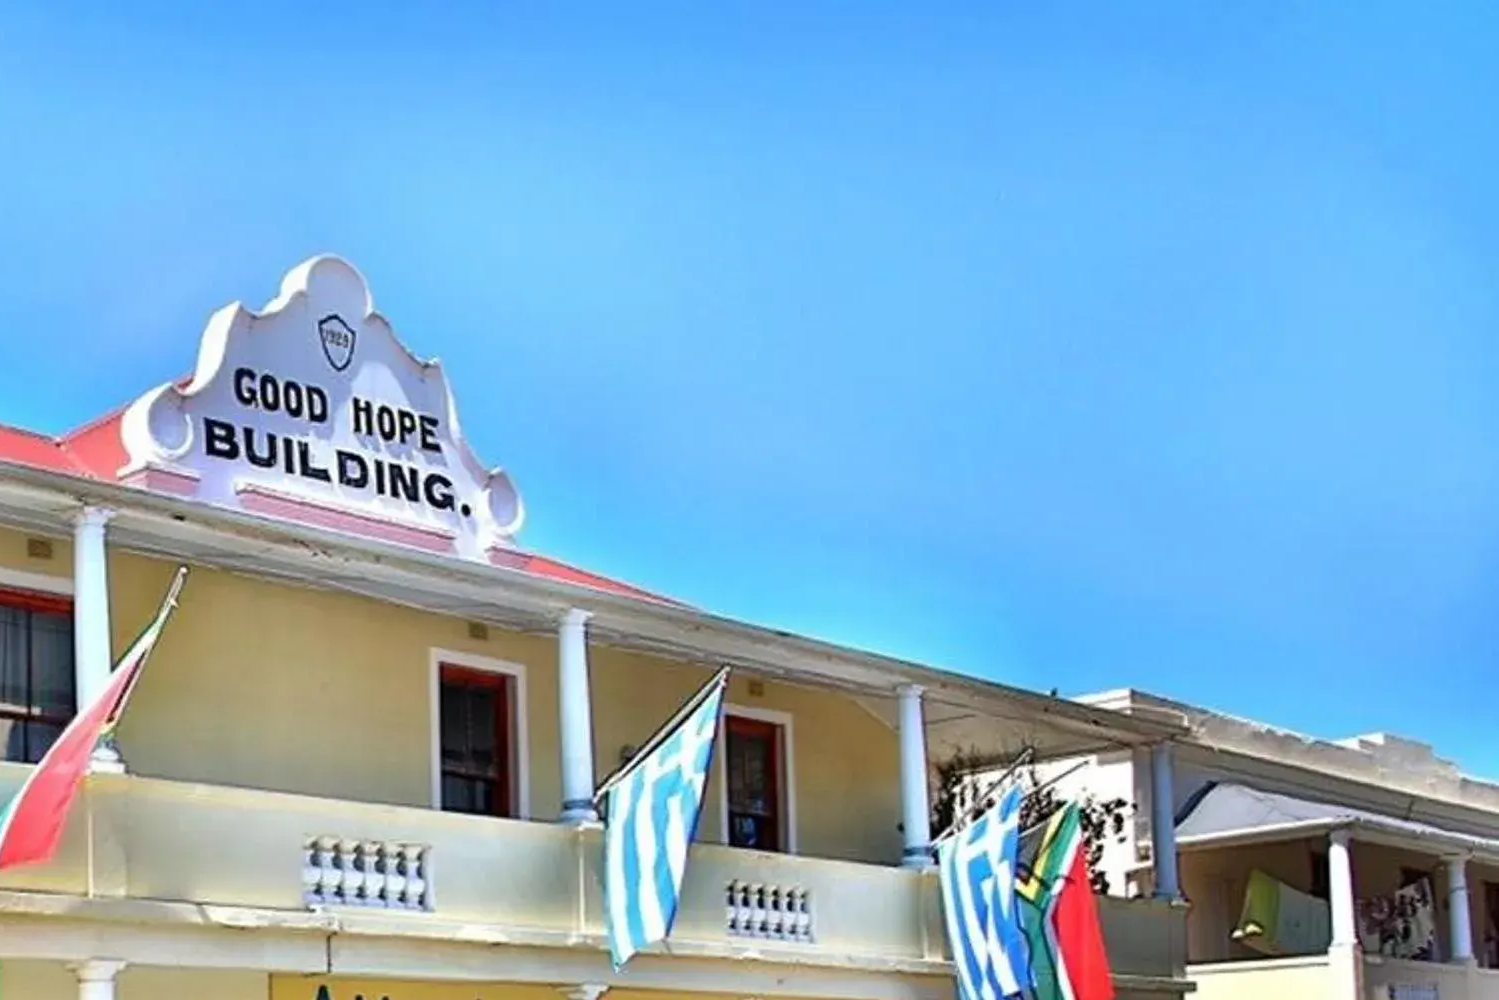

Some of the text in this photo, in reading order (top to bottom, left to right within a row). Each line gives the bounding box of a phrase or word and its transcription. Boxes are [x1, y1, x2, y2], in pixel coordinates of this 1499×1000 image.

[233, 367, 442, 453] GOOD HOPE
[203, 417, 472, 517] BUILDING.
